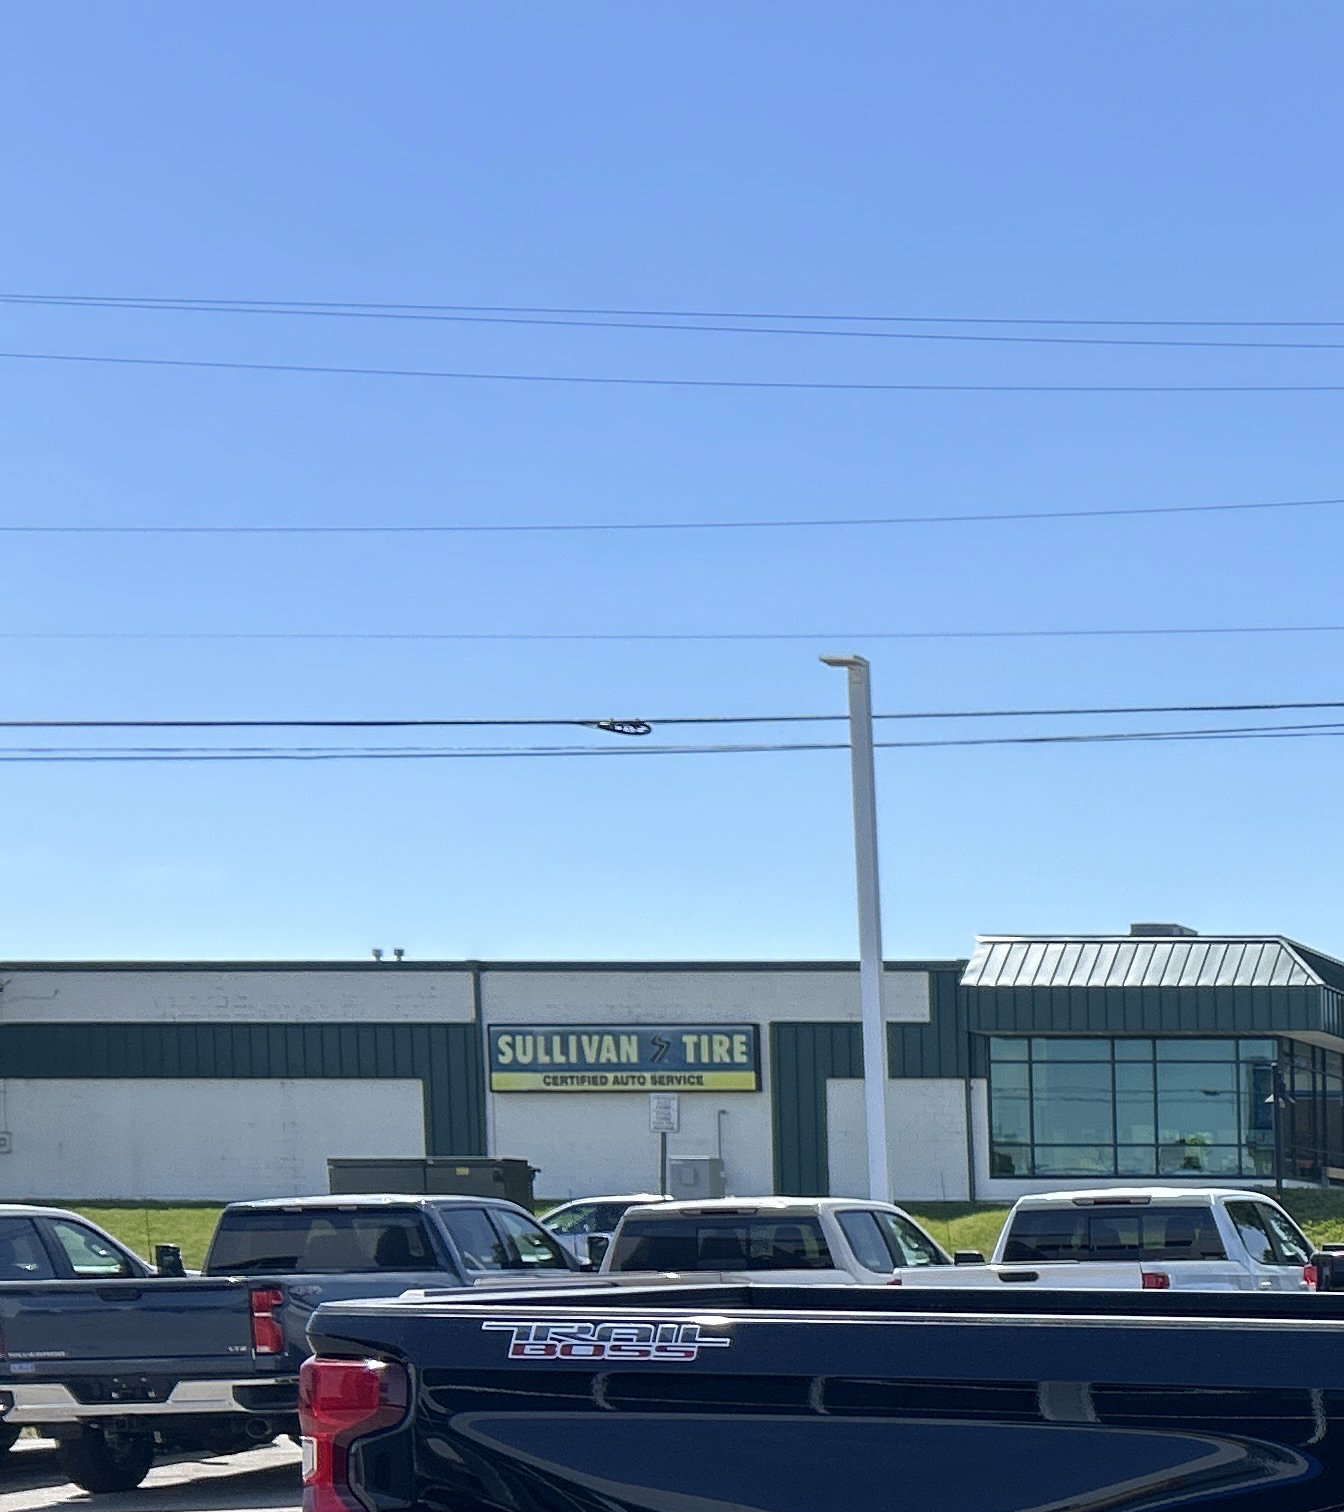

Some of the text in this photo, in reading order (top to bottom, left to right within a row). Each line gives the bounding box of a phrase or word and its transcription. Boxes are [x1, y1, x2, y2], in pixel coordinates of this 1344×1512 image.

[497, 1034, 748, 1065] SULLIVAN TIRE
[542, 1074, 704, 1087] CERTIFIED AUTO SERVICE
[481, 1321, 731, 1347] TRAIL
[508, 1341, 698, 1361] BOSS
